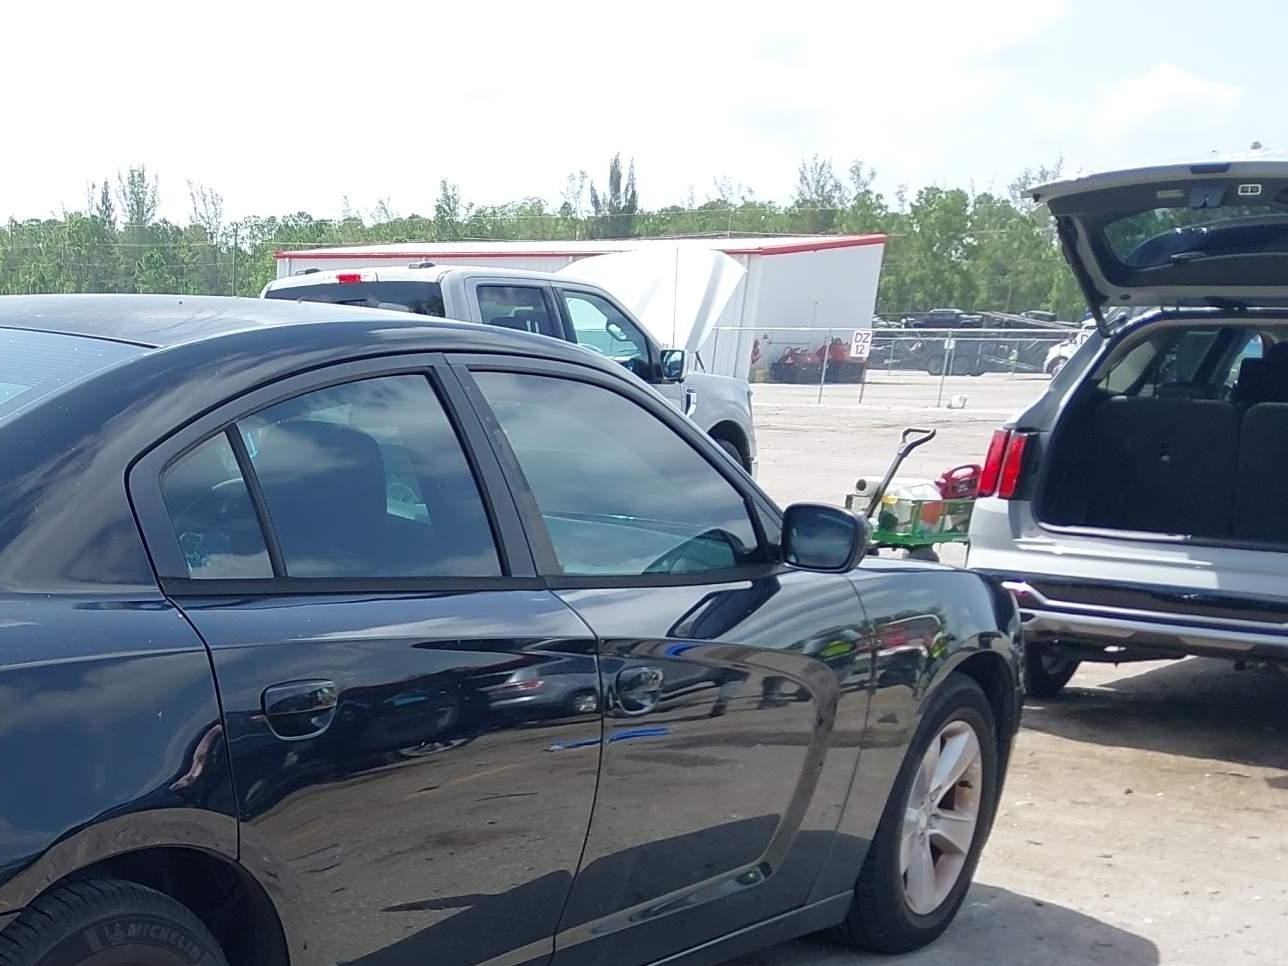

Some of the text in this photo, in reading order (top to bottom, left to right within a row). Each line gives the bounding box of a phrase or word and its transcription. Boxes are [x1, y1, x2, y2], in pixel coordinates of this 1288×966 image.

[855, 332, 871, 343] DZ
[855, 344, 865, 355] 12
[126, 922, 202, 960] MICHELIN
